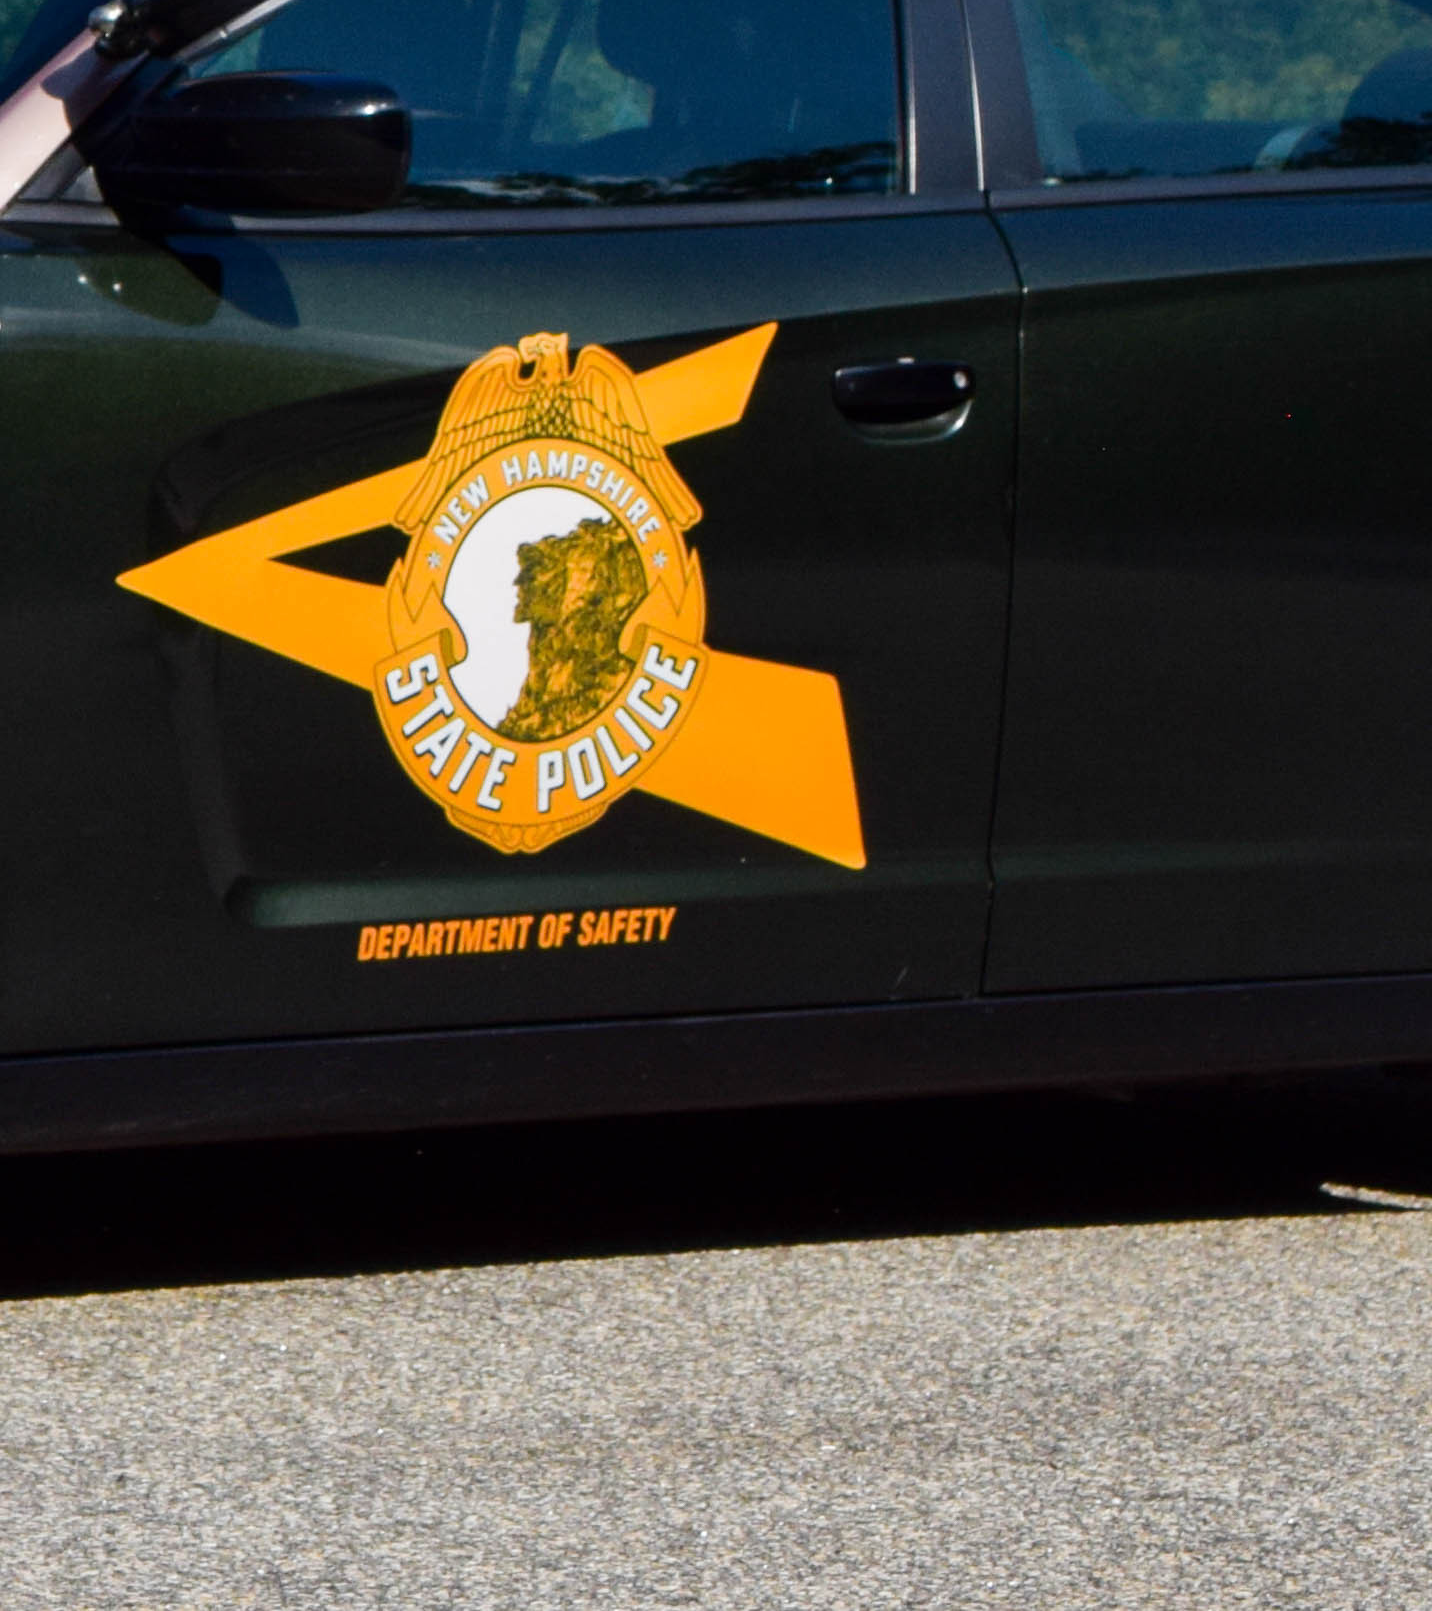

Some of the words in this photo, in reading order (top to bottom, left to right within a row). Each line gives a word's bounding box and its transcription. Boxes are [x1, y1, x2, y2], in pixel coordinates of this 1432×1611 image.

[433, 475, 489, 545] NEW
[502, 450, 661, 542] HAMPSHIRE
[385, 653, 518, 813] STATE
[536, 644, 697, 813] POLICE
[357, 914, 534, 961] DEPARTMENT
[538, 913, 571, 949] OF
[578, 906, 676, 946] SAFETY
